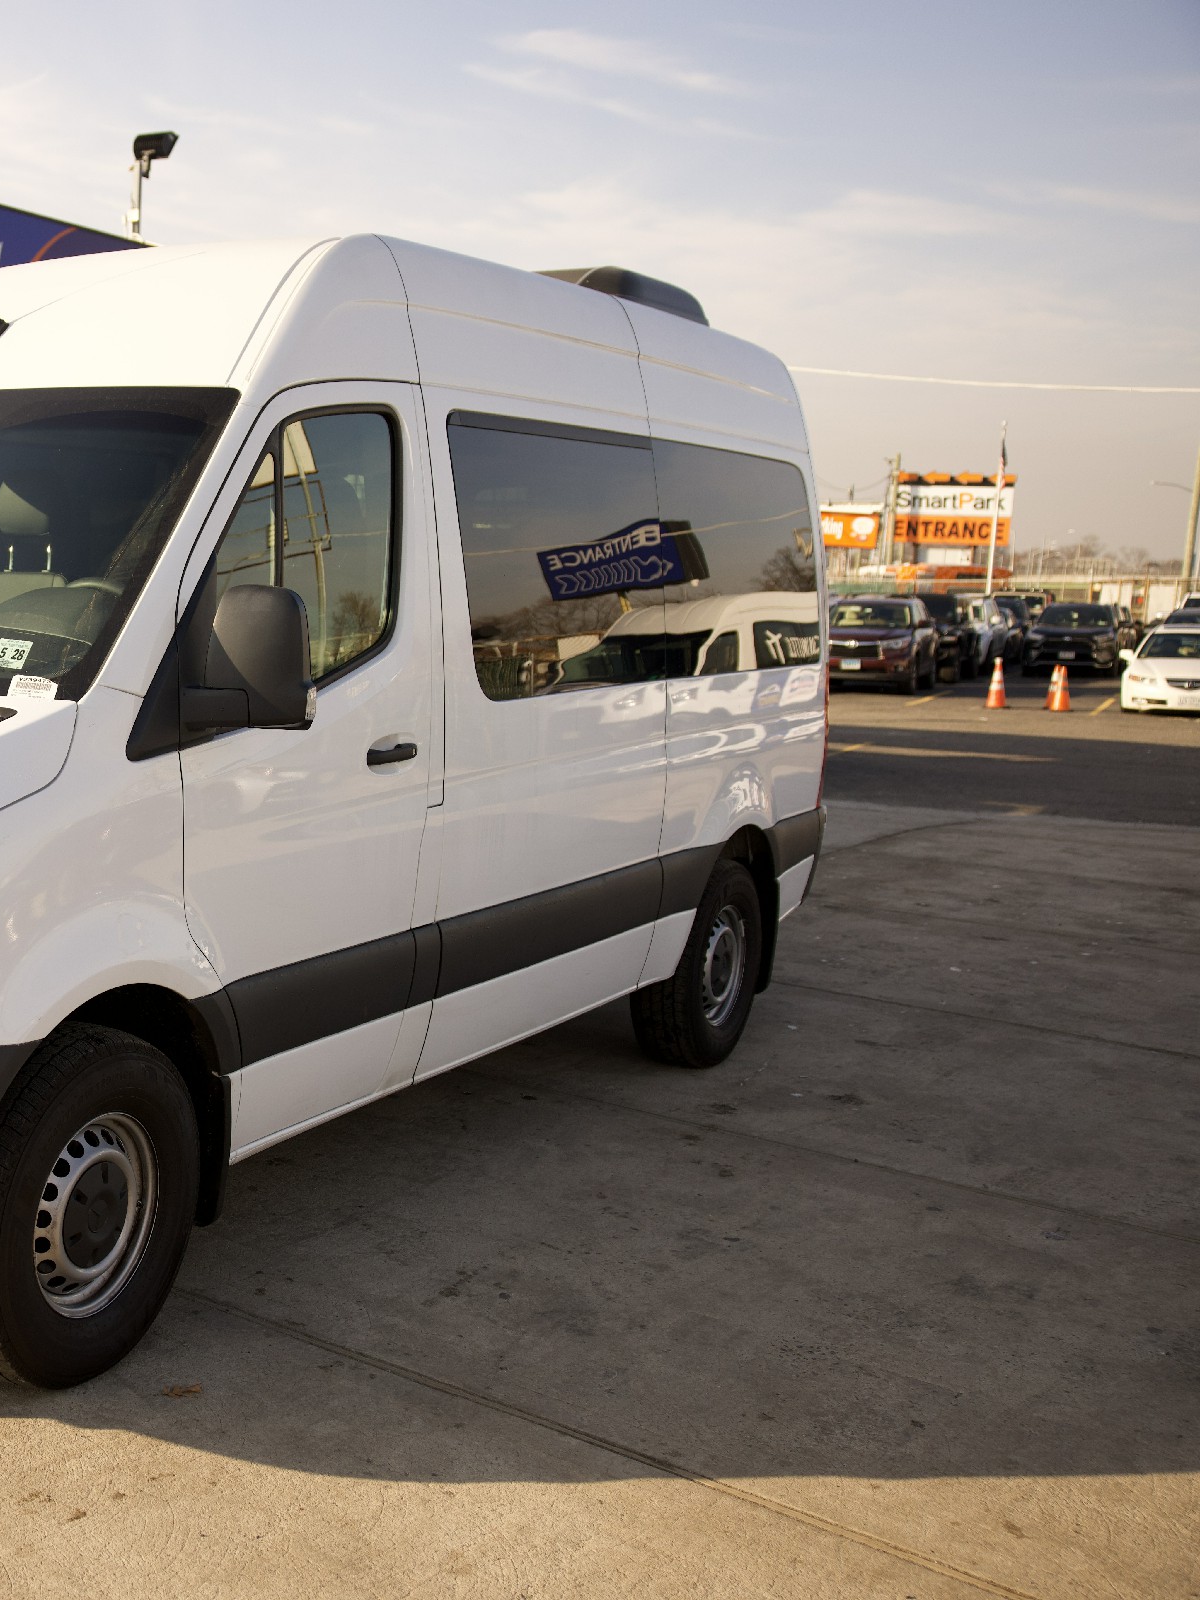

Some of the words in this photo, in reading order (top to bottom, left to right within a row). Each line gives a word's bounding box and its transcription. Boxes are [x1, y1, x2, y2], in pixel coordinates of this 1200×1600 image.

[896, 491, 1005, 511] SmartPark
[894, 520, 1006, 540] ENTRANCE
[10, 649, 25, 660] 28
